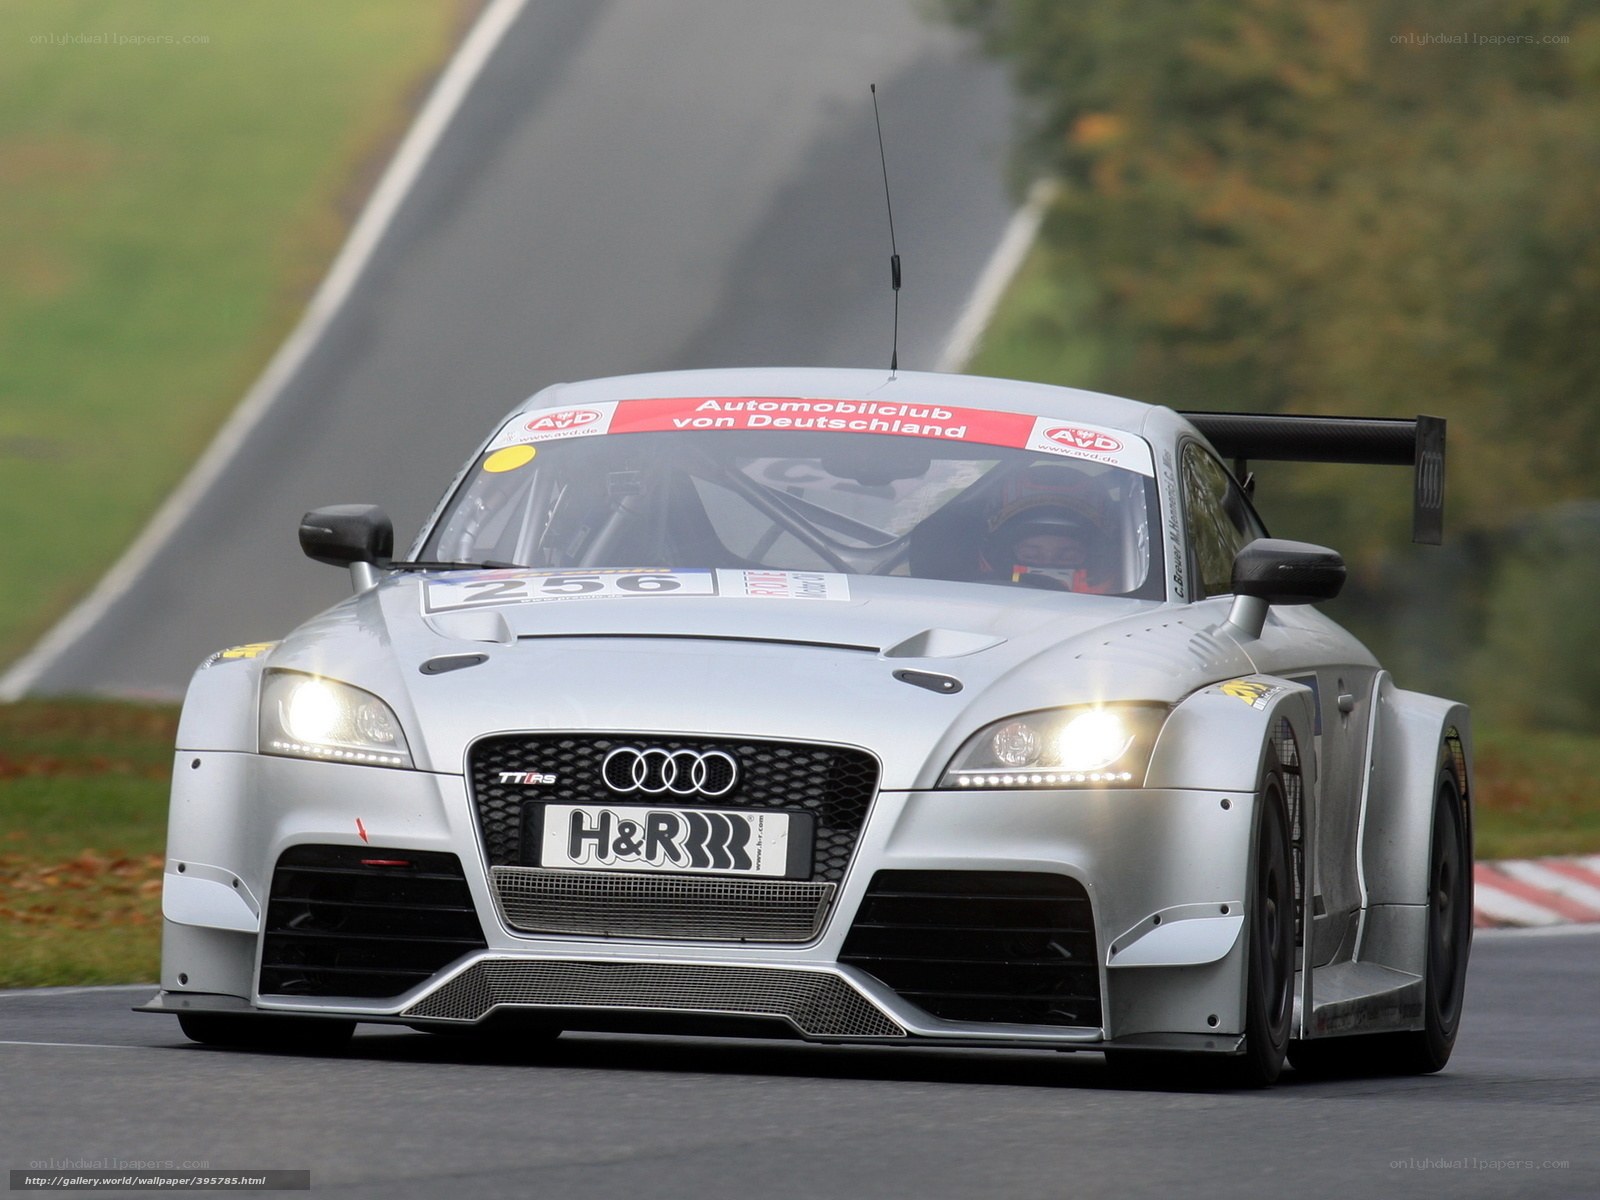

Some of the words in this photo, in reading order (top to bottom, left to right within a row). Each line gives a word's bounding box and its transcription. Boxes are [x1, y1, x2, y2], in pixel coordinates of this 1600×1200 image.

[529, 411, 599, 430] AvD
[695, 399, 953, 421] Automobilclub
[519, 429, 598, 443] www.avd.de
[672, 416, 735, 428] von
[747, 414, 967, 439] Deutschland
[1051, 429, 1118, 449] AvD
[1038, 444, 1119, 465] www.avd.de
[463, 574, 682, 602] 256
[568, 809, 692, 868] H&R
[756, 815, 765, 871] www.h-r.com
